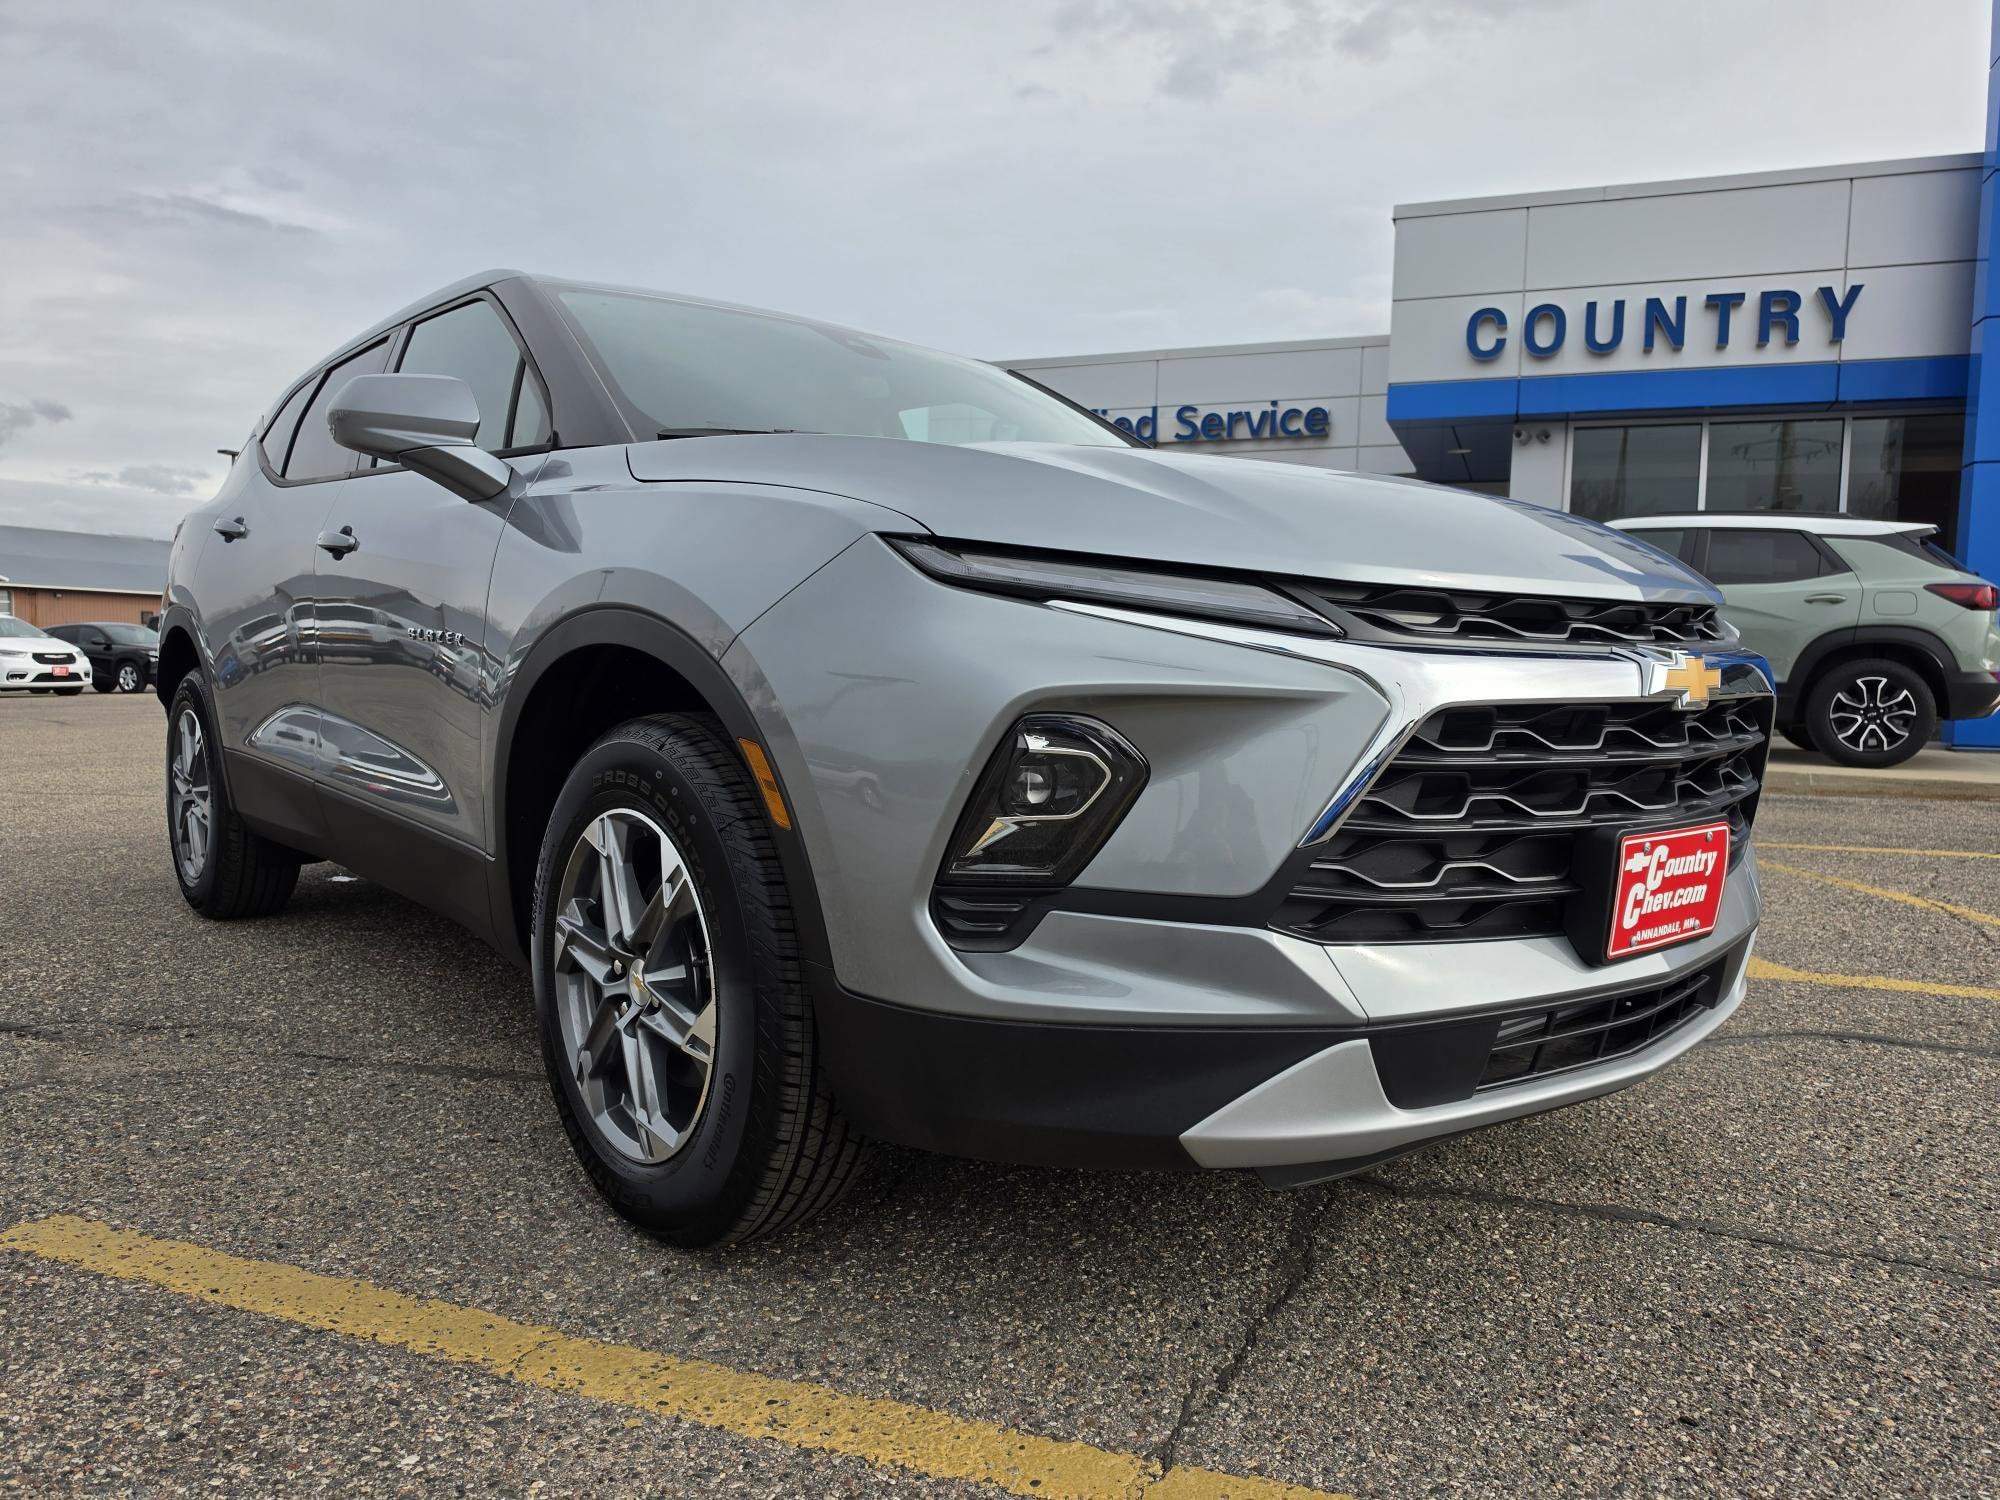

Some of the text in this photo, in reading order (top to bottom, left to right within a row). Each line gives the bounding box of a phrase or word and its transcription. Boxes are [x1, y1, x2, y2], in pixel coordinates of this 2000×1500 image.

[1466, 284, 1865, 361] COUNTRY
[1174, 400, 1330, 441] Service
[1646, 845, 1718, 890] Country
[1622, 882, 1708, 929] Chev.com
